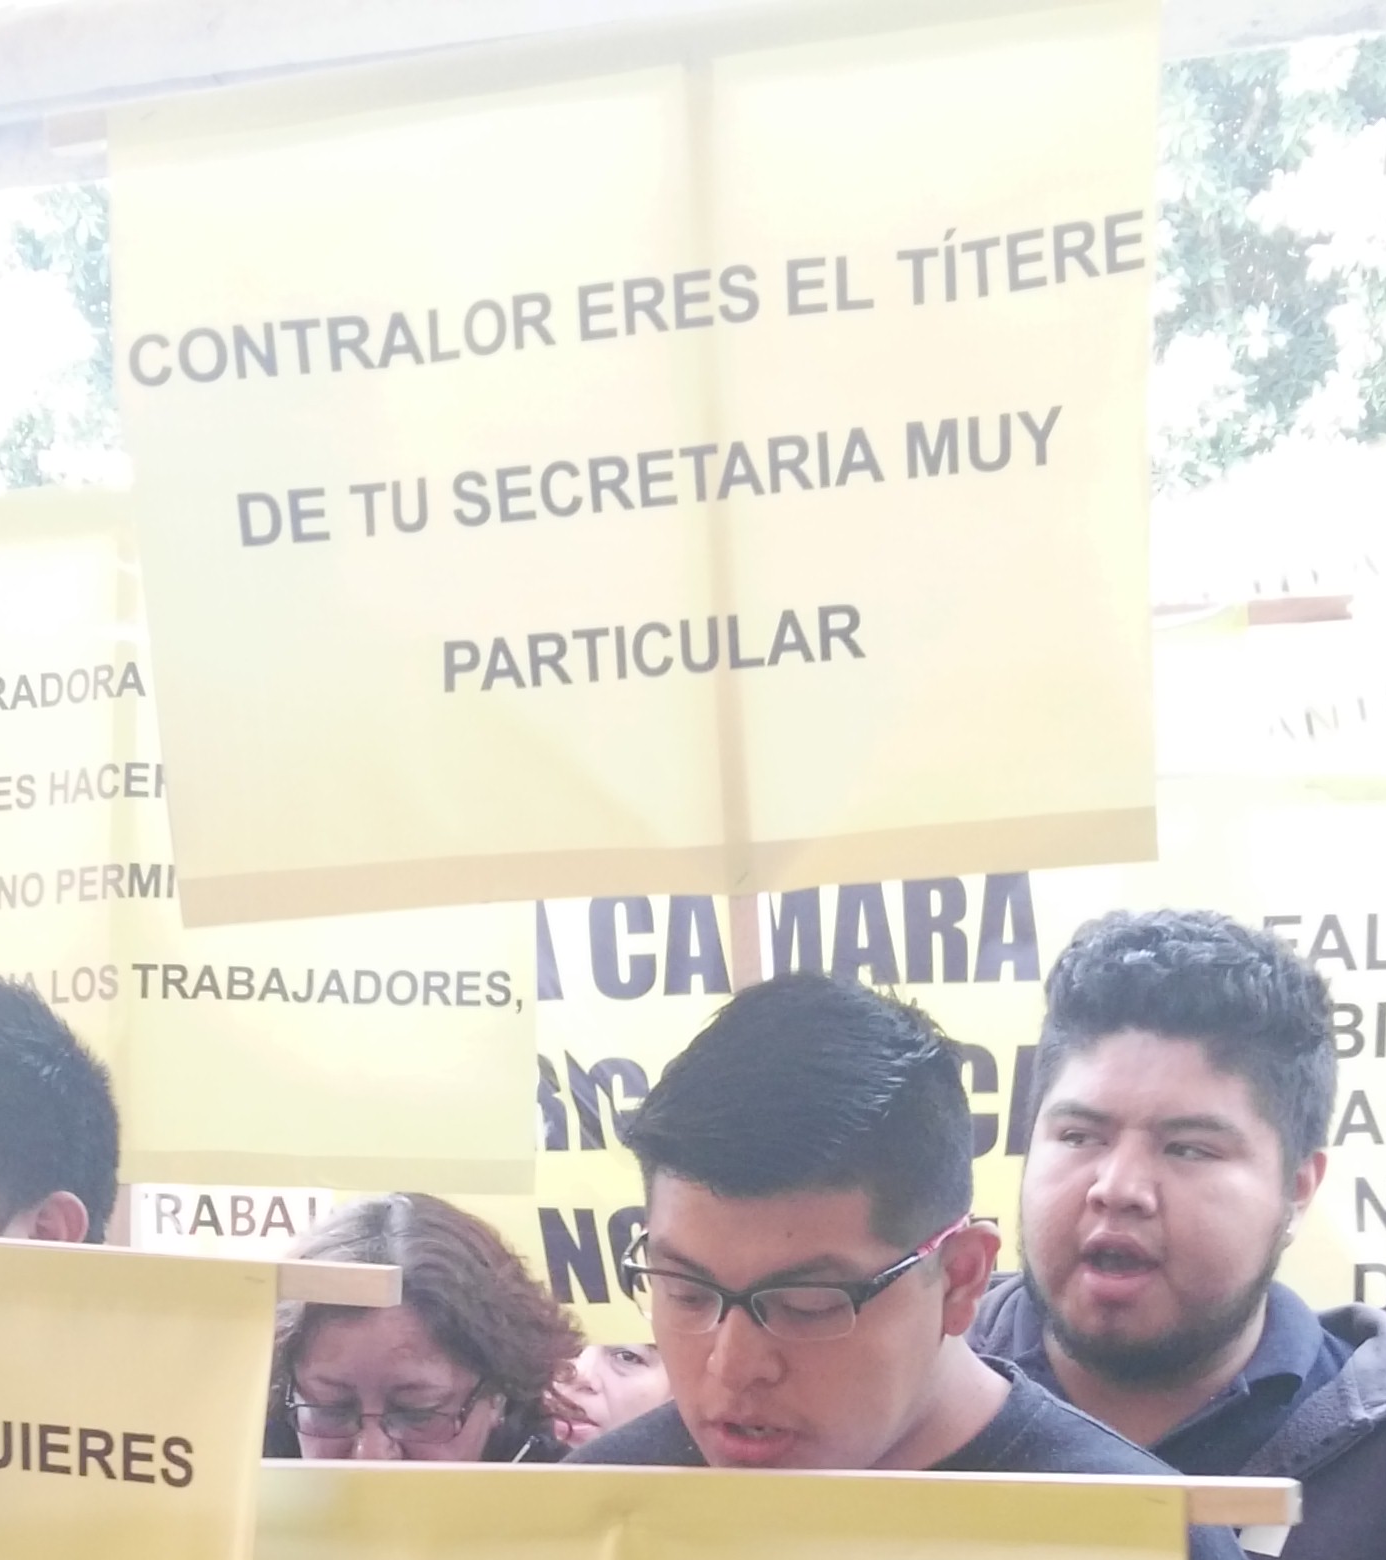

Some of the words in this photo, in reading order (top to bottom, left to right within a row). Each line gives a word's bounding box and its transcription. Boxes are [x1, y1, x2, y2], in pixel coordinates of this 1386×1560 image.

[128, 291, 556, 391] CONTRALOR
[577, 264, 762, 344] ERES
[786, 254, 875, 318] EL
[896, 208, 1148, 305] TÍTERE
[236, 487, 331, 548] DE
[350, 477, 430, 538] TU
[453, 424, 884, 528] SECRETARIA
[905, 405, 1064, 480] MUY
[442, 602, 866, 694] PARTICULAR
[51, 965, 119, 1005] LOS
[131, 962, 524, 1013] TRABAJADORES,
